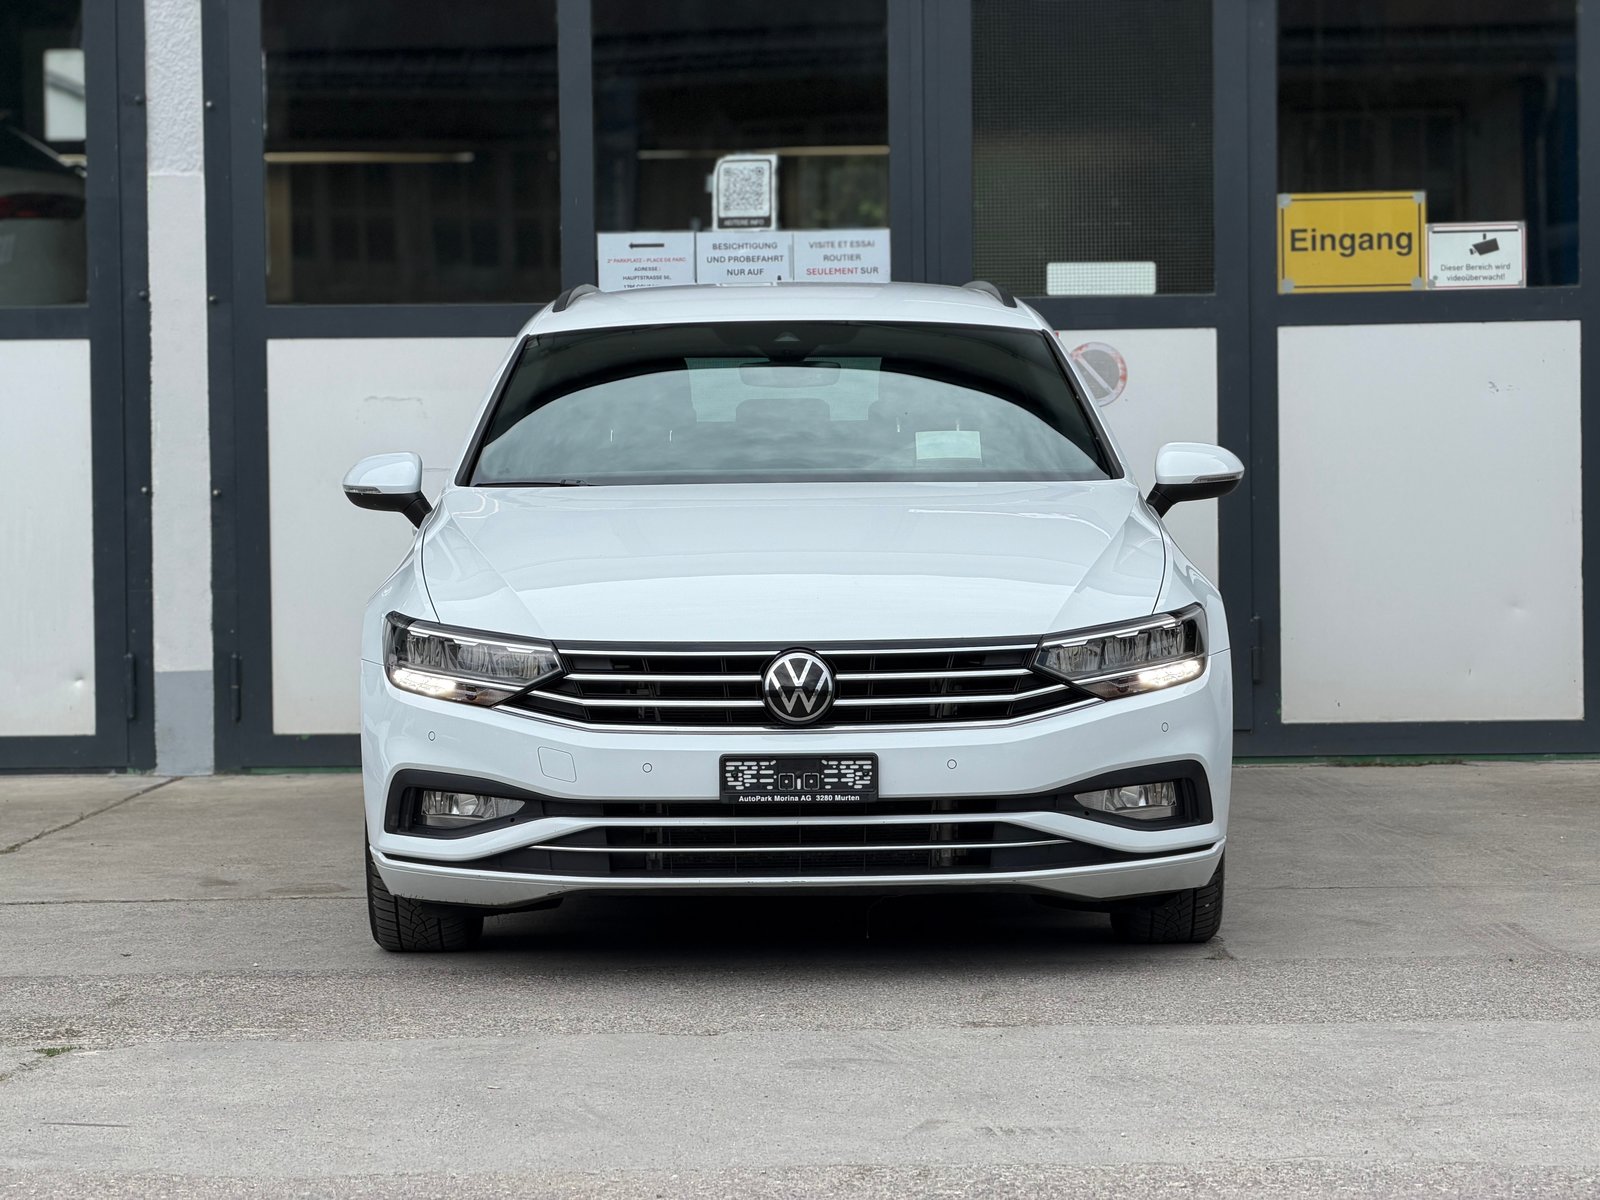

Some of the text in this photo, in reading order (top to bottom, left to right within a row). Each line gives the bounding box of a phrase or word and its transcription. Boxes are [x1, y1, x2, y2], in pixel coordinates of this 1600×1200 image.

[712, 242, 778, 251] BESICHTIGUNG
[808, 240, 875, 249] VISITE ET ESSAI
[1290, 228, 1414, 258] Eingang
[706, 255, 784, 264] UND PROBEFAHRT
[823, 254, 862, 262] ROUTIER
[806, 266, 879, 276] SEULEMENT SUR
[1440, 262, 1511, 272] Dieser Bereich wird
[726, 268, 765, 277] NUR AUF
[1446, 273, 1506, 282] videoüberwacht!
[764, 652, 833, 721] VW
